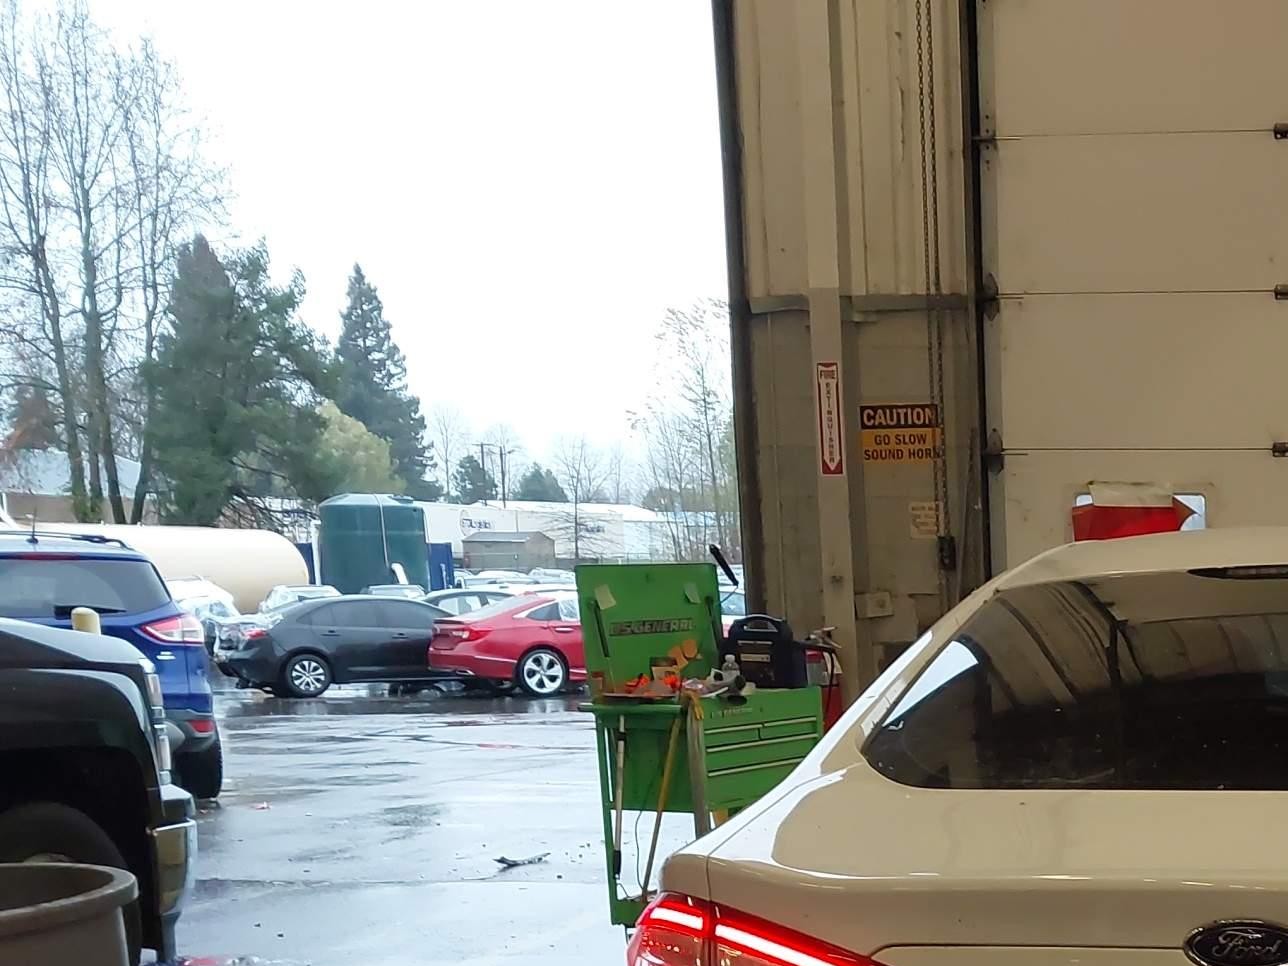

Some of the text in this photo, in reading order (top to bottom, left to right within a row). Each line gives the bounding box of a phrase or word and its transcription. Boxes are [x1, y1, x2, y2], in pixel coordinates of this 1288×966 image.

[820, 370, 835, 379] FIRE
[825, 382, 835, 463] EXTINGUISHER
[863, 408, 936, 426] CAUTION
[874, 433, 927, 445] GO SLOW
[864, 449, 904, 461] SOUND
[1211, 929, 1283, 959] Ford
